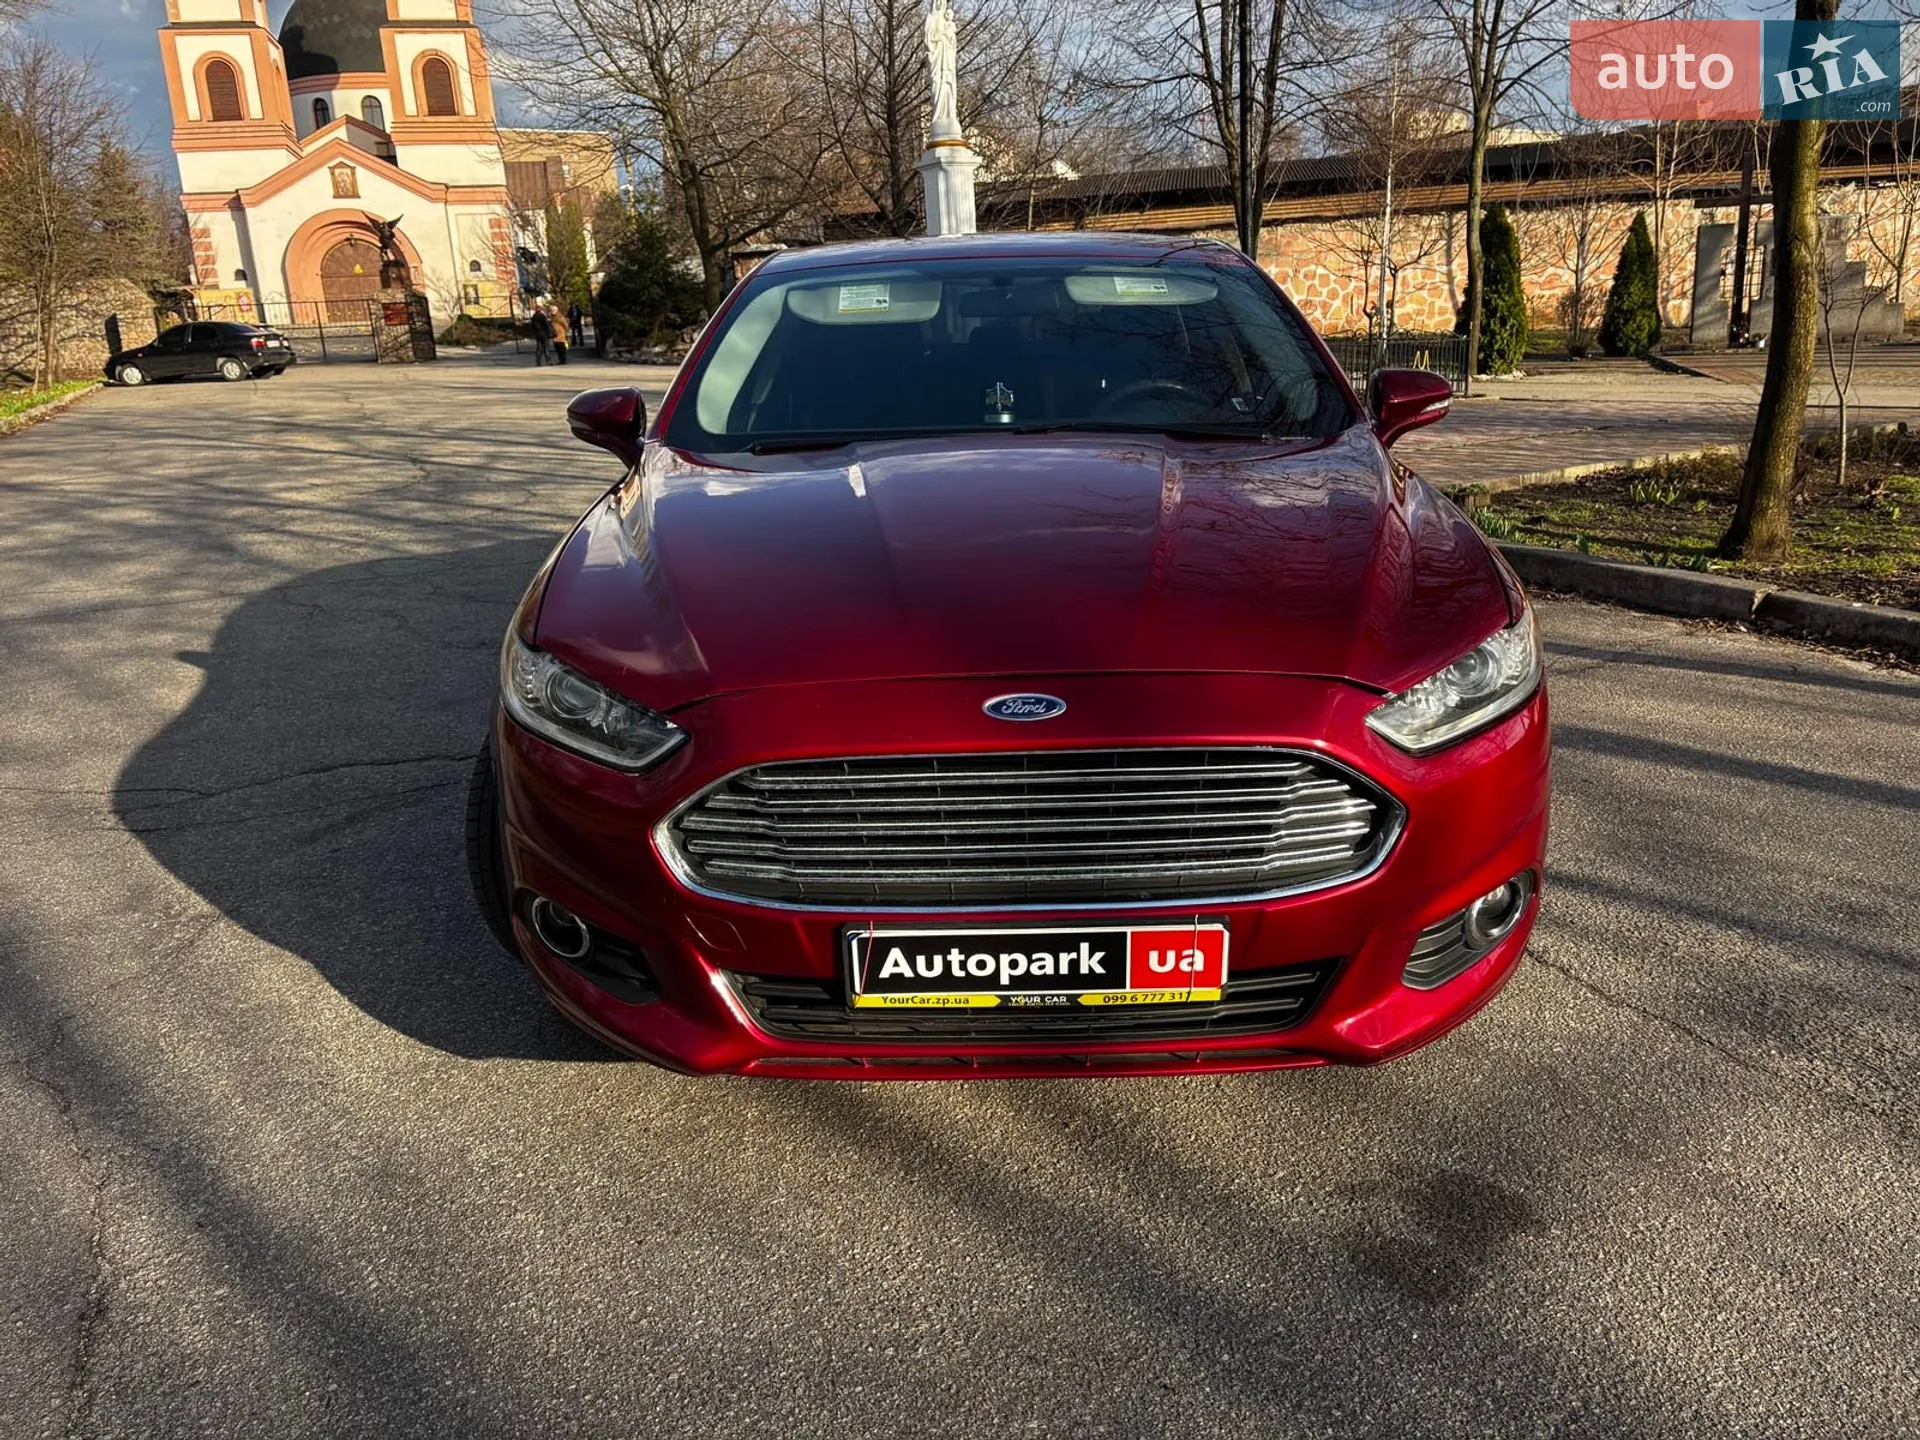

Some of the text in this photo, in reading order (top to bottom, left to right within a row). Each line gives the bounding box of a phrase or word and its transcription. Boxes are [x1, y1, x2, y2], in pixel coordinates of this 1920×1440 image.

[1001, 698, 1047, 714] Ford
[878, 942, 1205, 985] Autopark ua
[881, 995, 970, 1007] YourCar.zp.ua
[1045, 995, 1067, 1003] CAR
[1103, 995, 1127, 1004] 099
[1130, 994, 1138, 1002] 6
[1142, 992, 1166, 1001] 777
